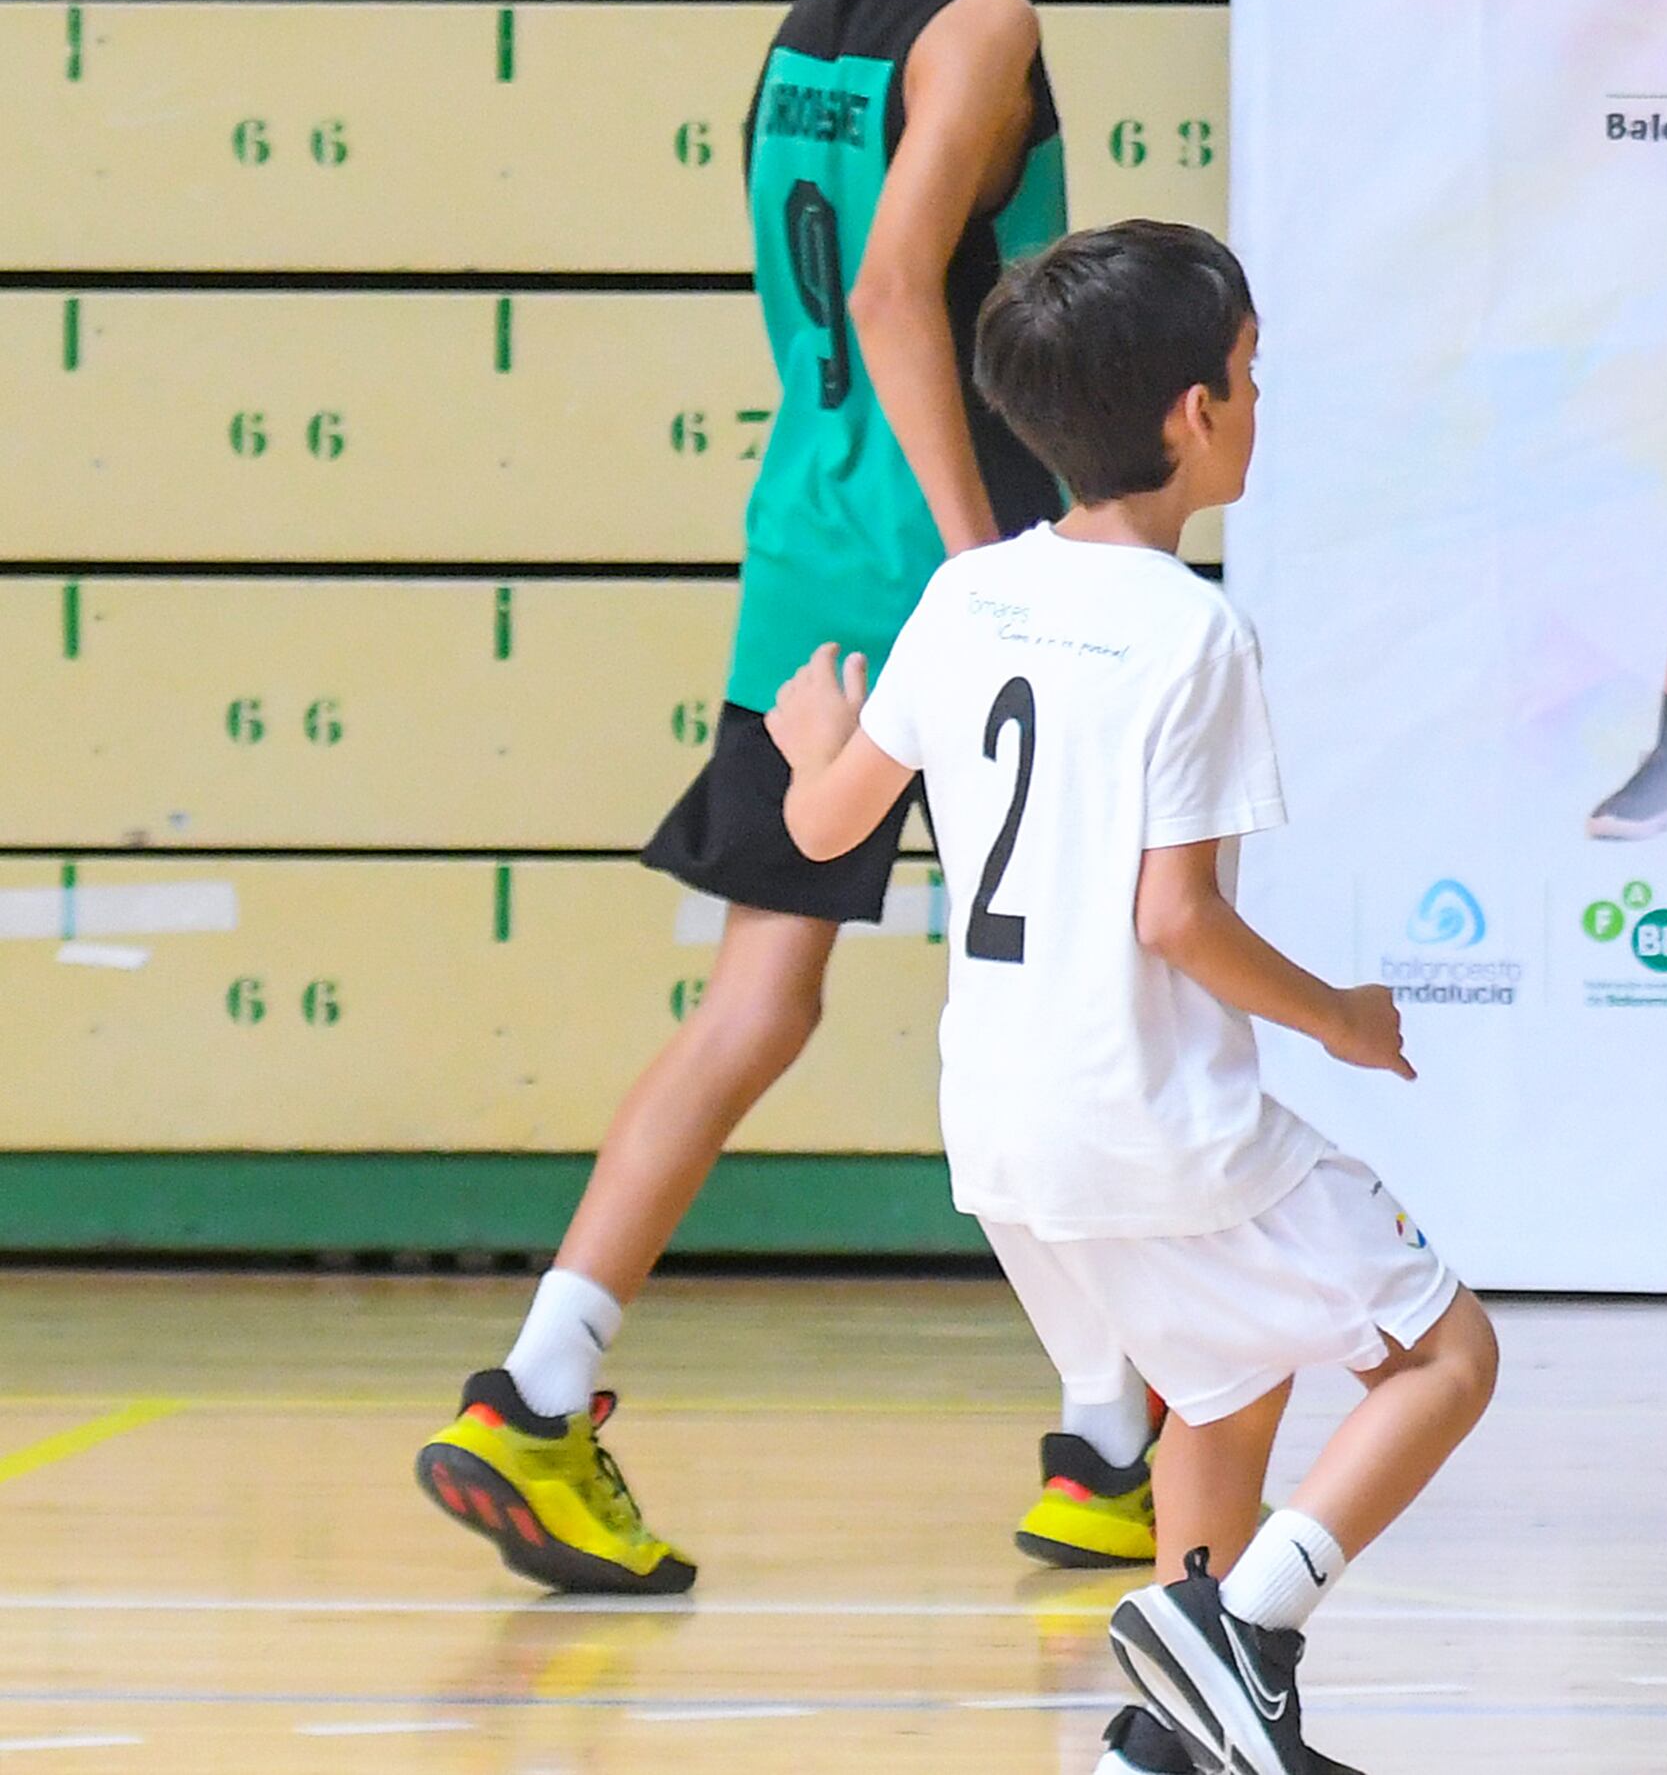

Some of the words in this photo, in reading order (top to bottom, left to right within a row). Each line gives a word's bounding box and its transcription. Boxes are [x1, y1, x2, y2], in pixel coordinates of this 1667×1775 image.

[231, 119, 349, 168] 66
[785, 179, 850, 410] 9
[229, 410, 346, 460] 66
[226, 698, 344, 746] 66
[965, 675, 1037, 963] 2
[225, 978, 341, 1027] 66
[1394, 983, 1515, 1005] ndalucia
